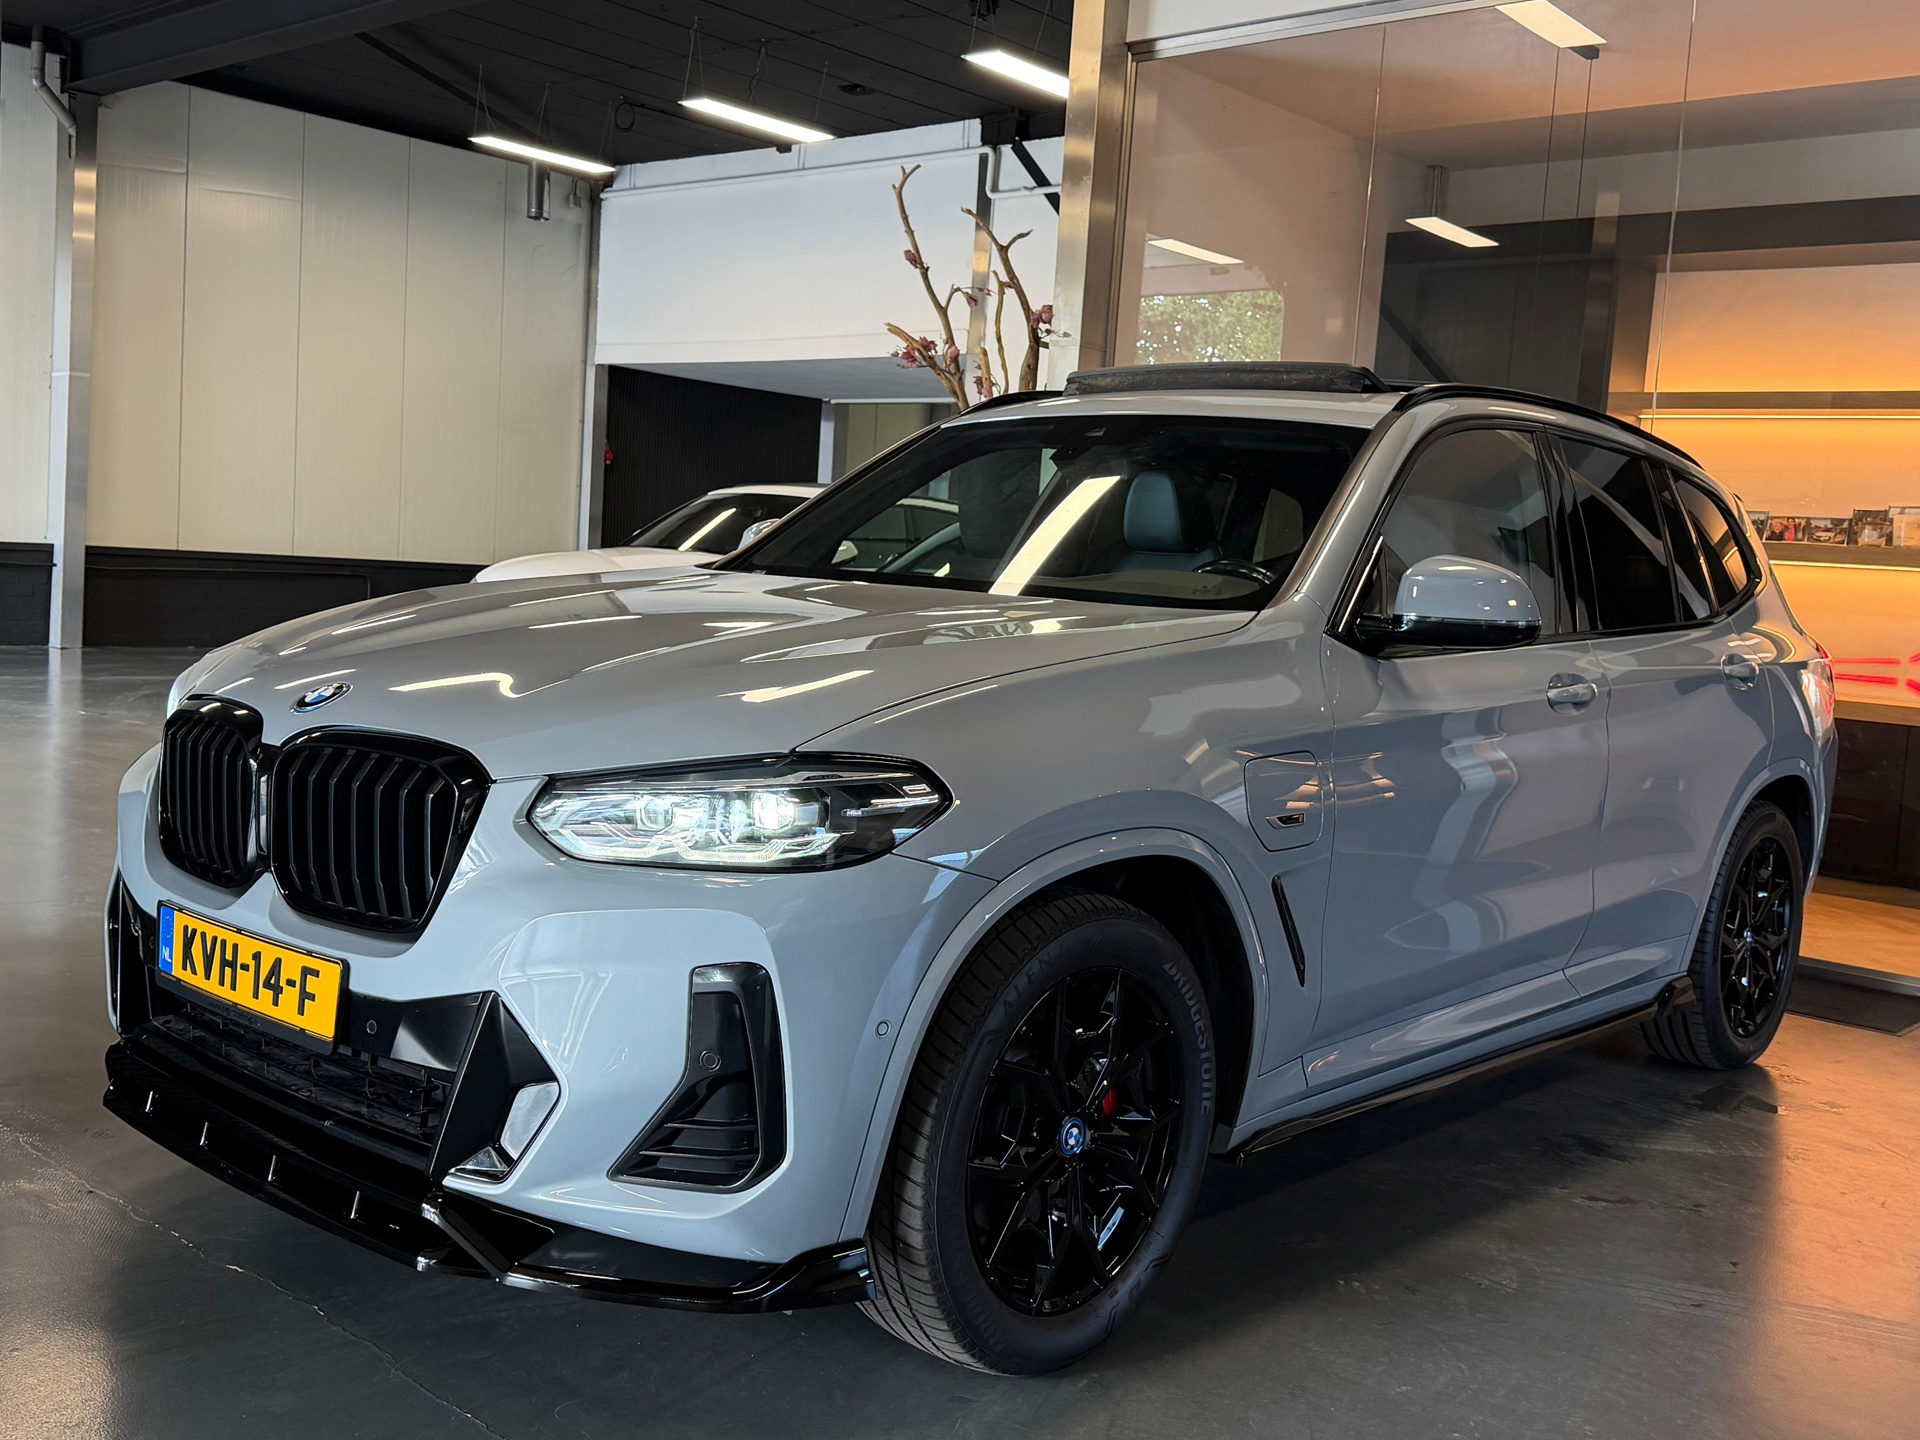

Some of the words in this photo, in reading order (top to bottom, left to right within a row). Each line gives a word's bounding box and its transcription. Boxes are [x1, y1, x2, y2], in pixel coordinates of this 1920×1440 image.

[162, 944, 173, 963] NL
[181, 923, 321, 1017] KVH-14-F
[1162, 959, 1213, 1115] BRIDGESTONE
